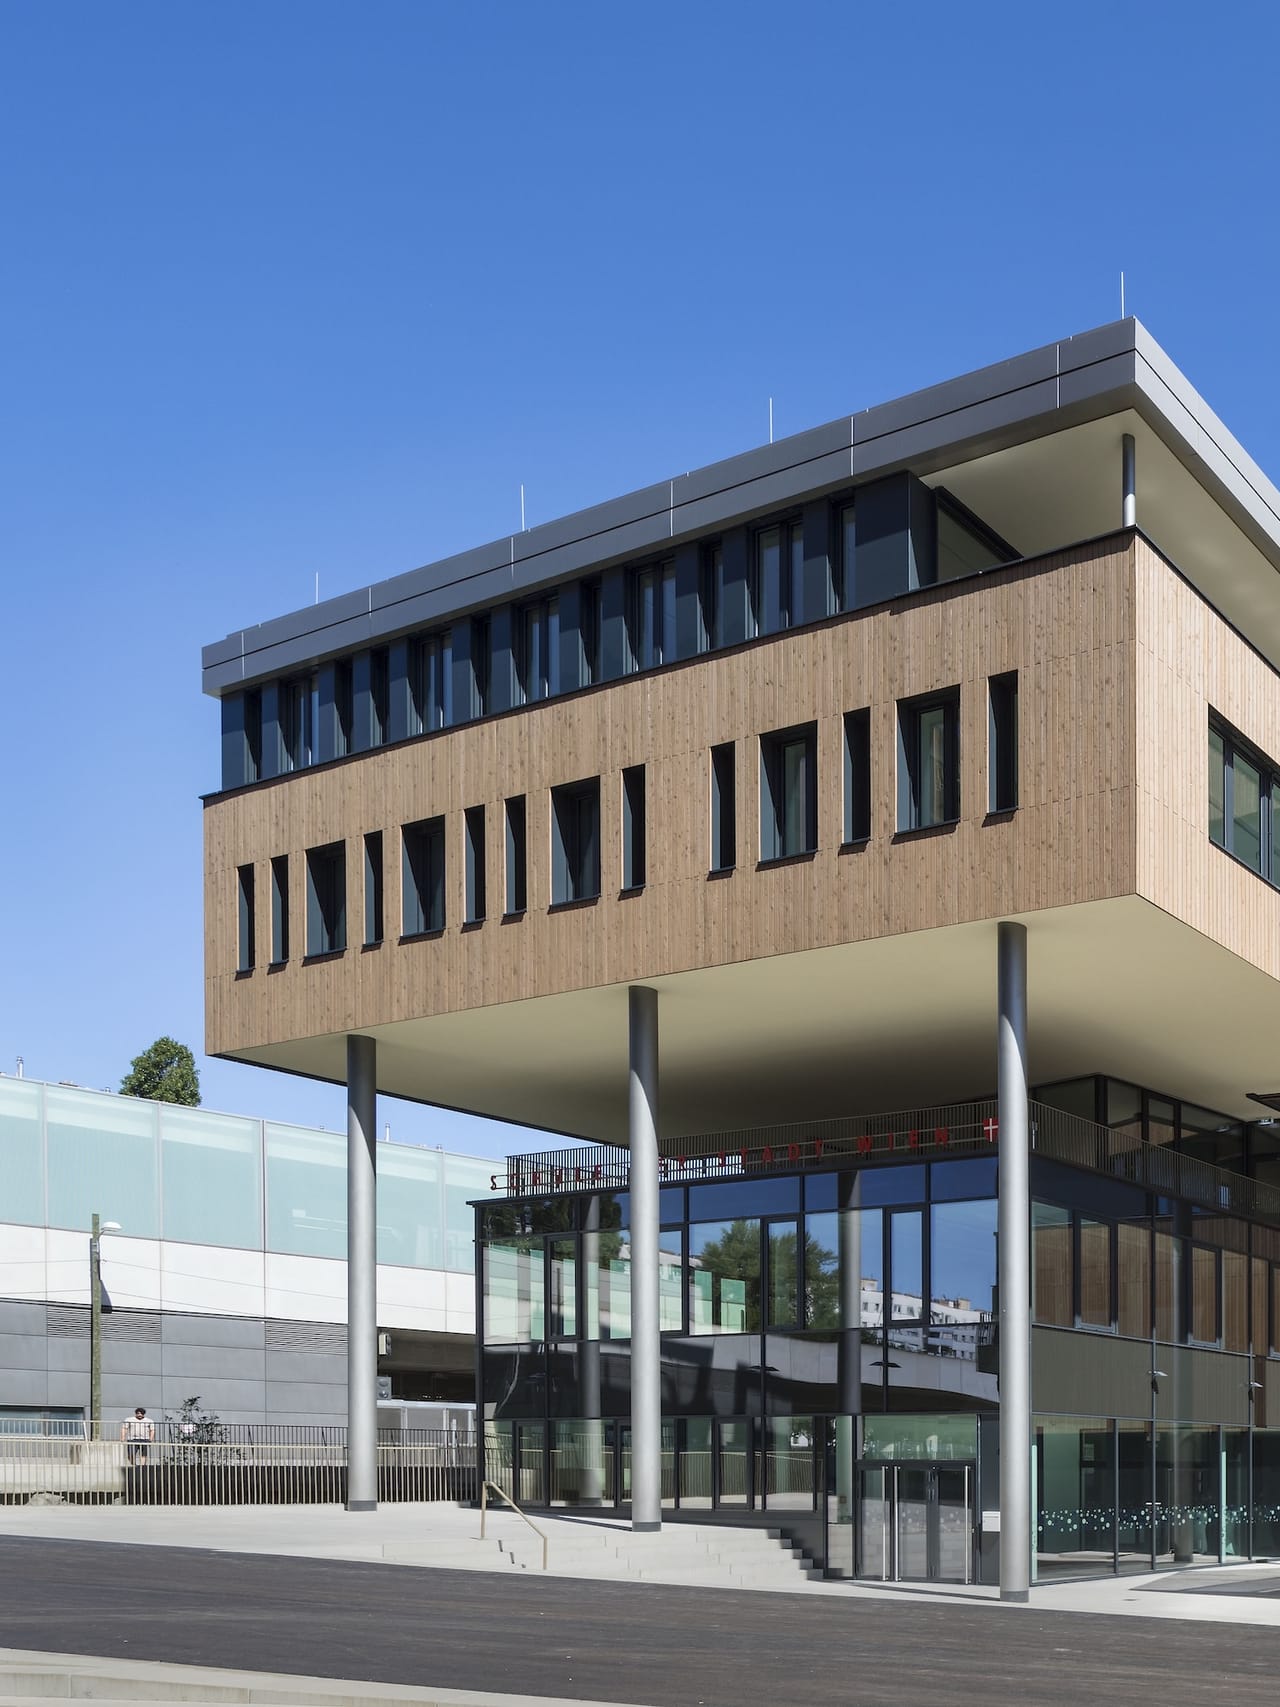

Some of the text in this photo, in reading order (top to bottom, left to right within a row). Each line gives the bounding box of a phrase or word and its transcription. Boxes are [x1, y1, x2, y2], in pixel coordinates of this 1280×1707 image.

[490, 1164, 602, 1191] SCHULE
[718, 1138, 823, 1167] STADT
[857, 1125, 948, 1153] WIEN
